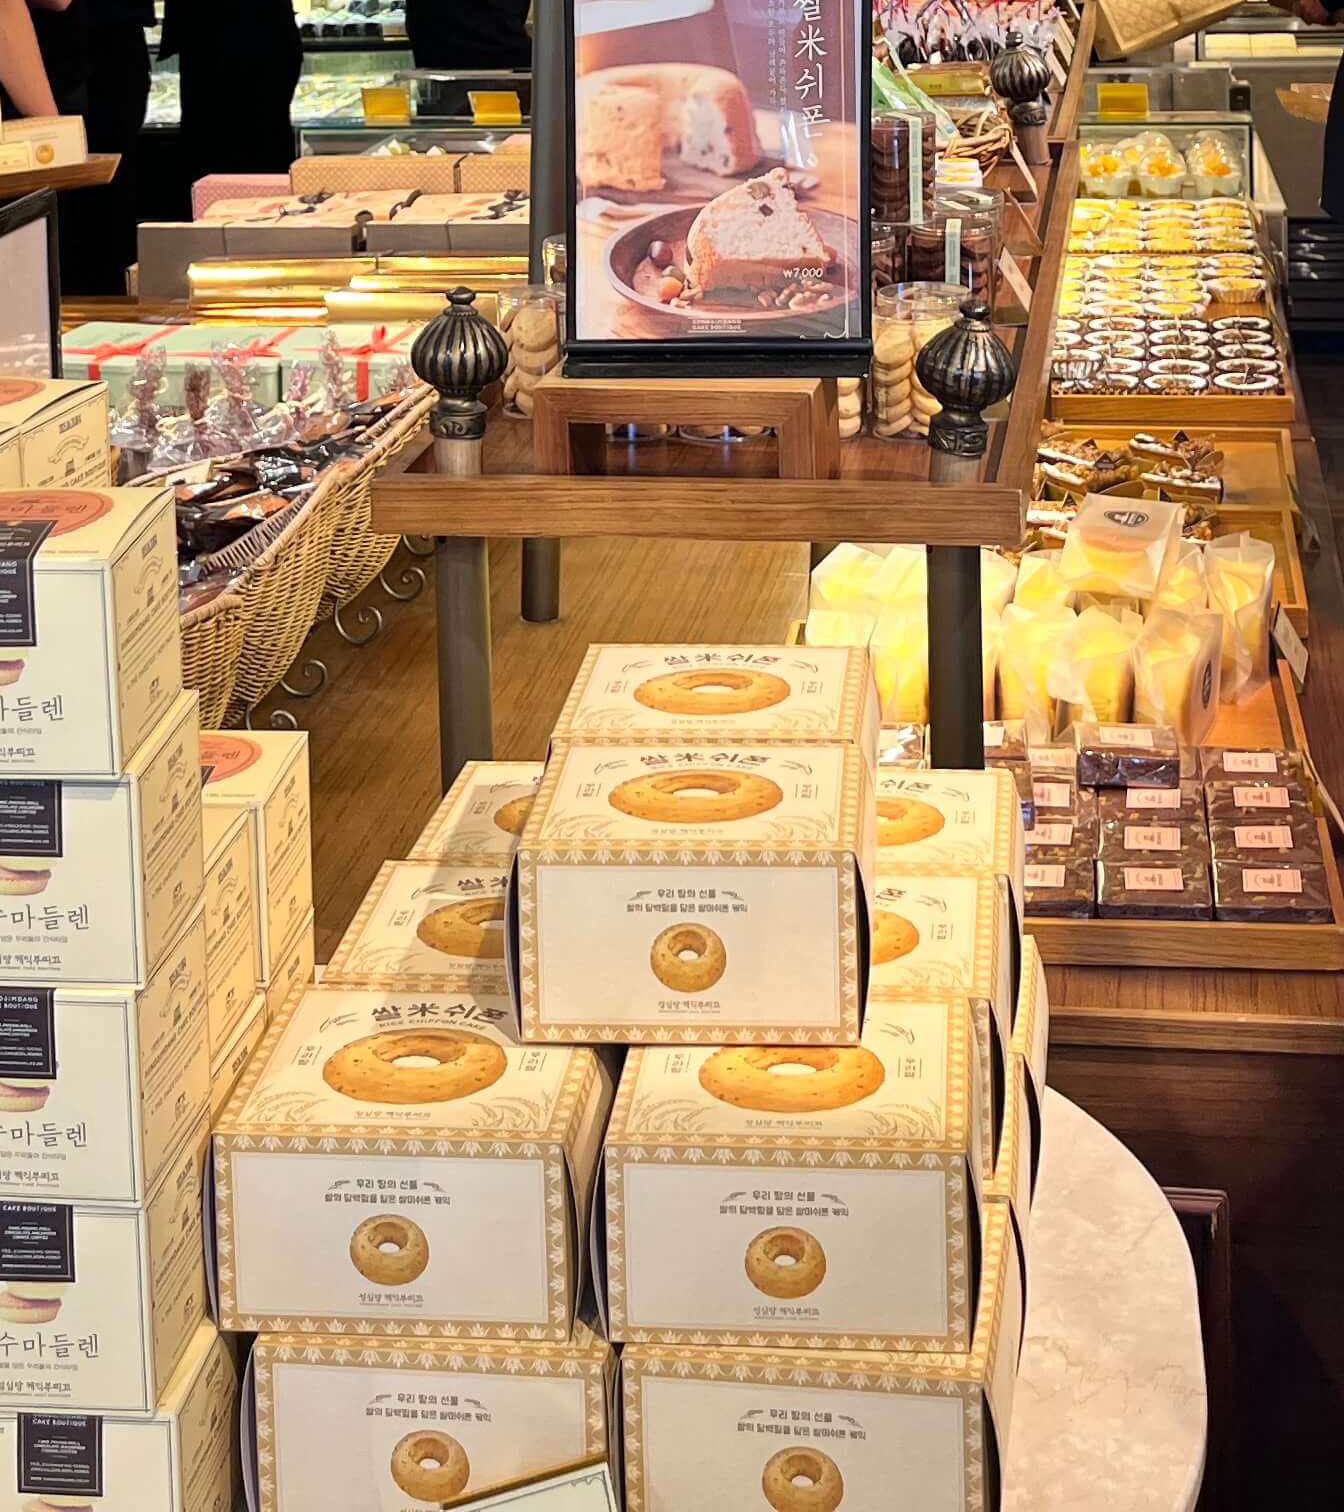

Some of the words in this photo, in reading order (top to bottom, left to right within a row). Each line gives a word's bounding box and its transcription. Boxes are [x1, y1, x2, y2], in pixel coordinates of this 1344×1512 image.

[640, 752, 771, 766] 쌀米쉬폰
[657, 889, 674, 898] 우리
[371, 1002, 509, 1024] 쌀米쉬폰
[356, 1179, 374, 1188] 우리
[752, 1191, 770, 1200] 우리
[398, 1393, 415, 1403] 우리
[770, 1409, 787, 1419] 우리
